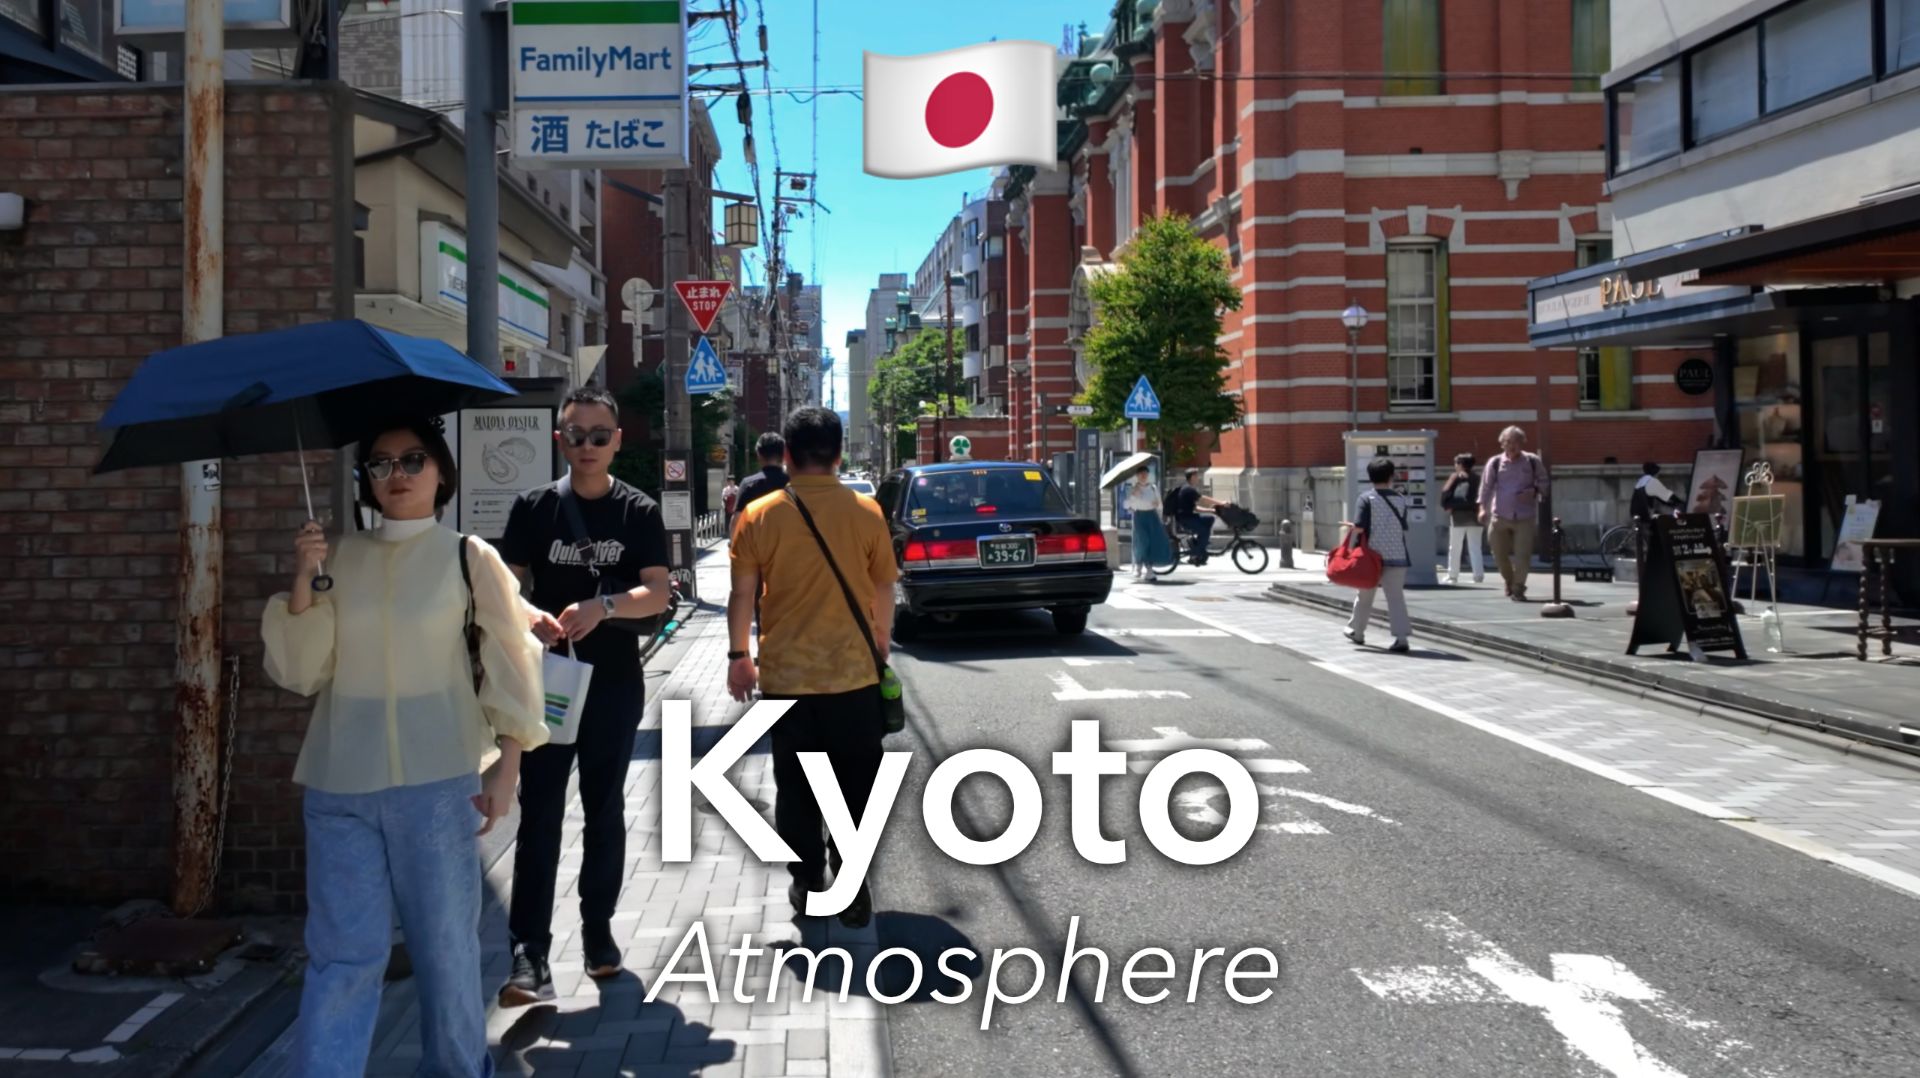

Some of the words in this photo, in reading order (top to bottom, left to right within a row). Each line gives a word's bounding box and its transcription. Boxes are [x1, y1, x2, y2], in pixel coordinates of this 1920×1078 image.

[520, 46, 672, 78] FamilyMart
[531, 115, 569, 154] 酒
[586, 119, 665, 149] たばこ
[686, 286, 722, 299] 止まれ
[1601, 273, 1662, 305] PAUL
[692, 301, 717, 311] STOP
[1680, 367, 1711, 379] PAUL
[994, 549, 1026, 562] 39-67
